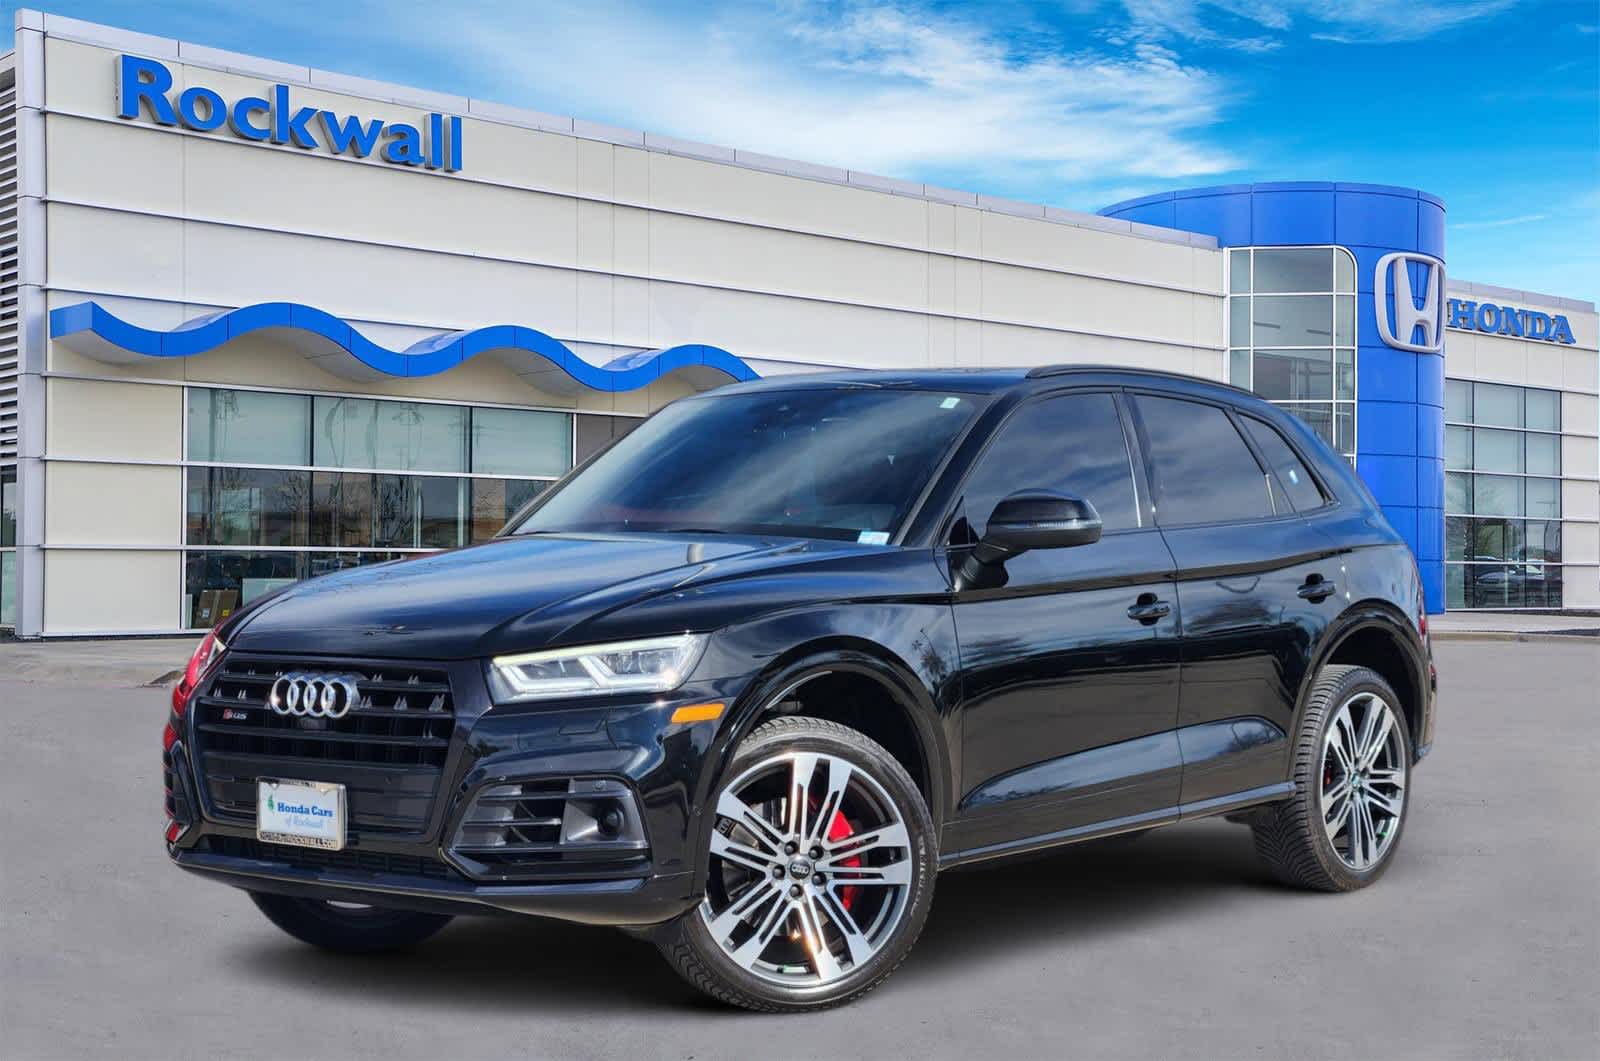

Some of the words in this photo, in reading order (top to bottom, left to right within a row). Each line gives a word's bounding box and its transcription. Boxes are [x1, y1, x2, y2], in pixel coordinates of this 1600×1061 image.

[117, 54, 462, 172] Rockwall
[1446, 299, 1576, 344] HONDA
[277, 802, 310, 815] Honda
[311, 806, 333, 818] Cars
